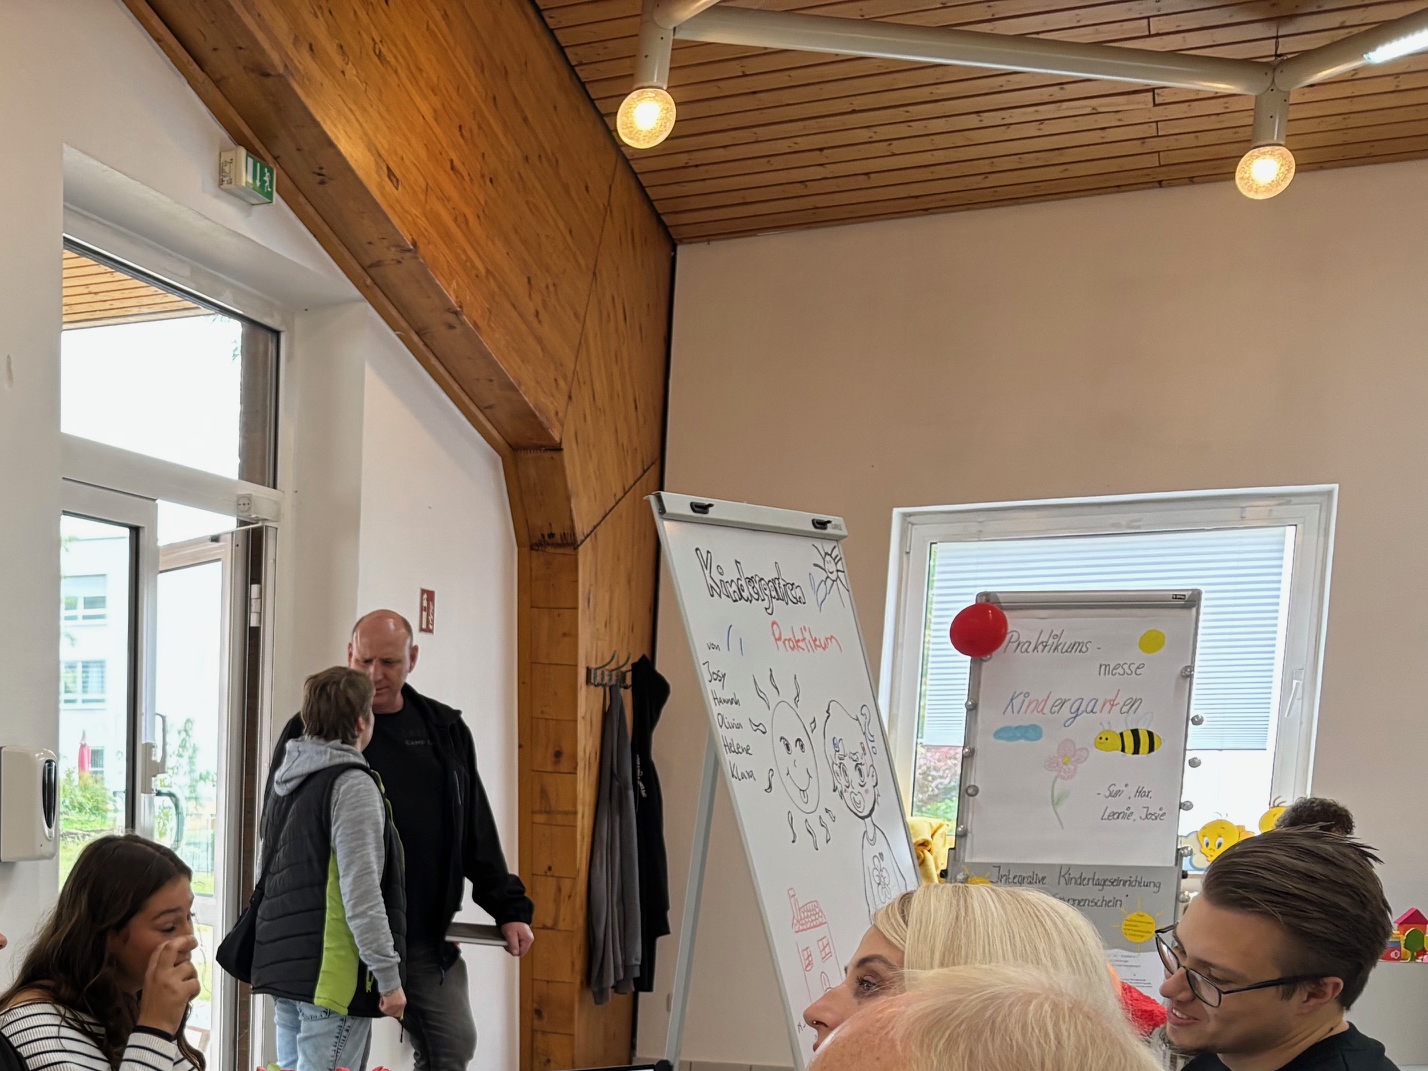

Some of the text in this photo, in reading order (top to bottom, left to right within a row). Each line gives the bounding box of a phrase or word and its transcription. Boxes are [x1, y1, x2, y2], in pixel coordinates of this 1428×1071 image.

[694, 546, 807, 615] Kindergarten
[770, 619, 843, 653] Praktikum
[706, 642, 721, 652] von
[1098, 661, 1146, 677] messe
[1002, 688, 1144, 728] Kindergarten
[716, 712, 744, 730] Olivia
[721, 735, 753, 756] Helene
[728, 760, 757, 782] Klara
[1139, 806, 1167, 821] Josie
[990, 865, 1162, 894] Integrative Kindertageseinrichtung
